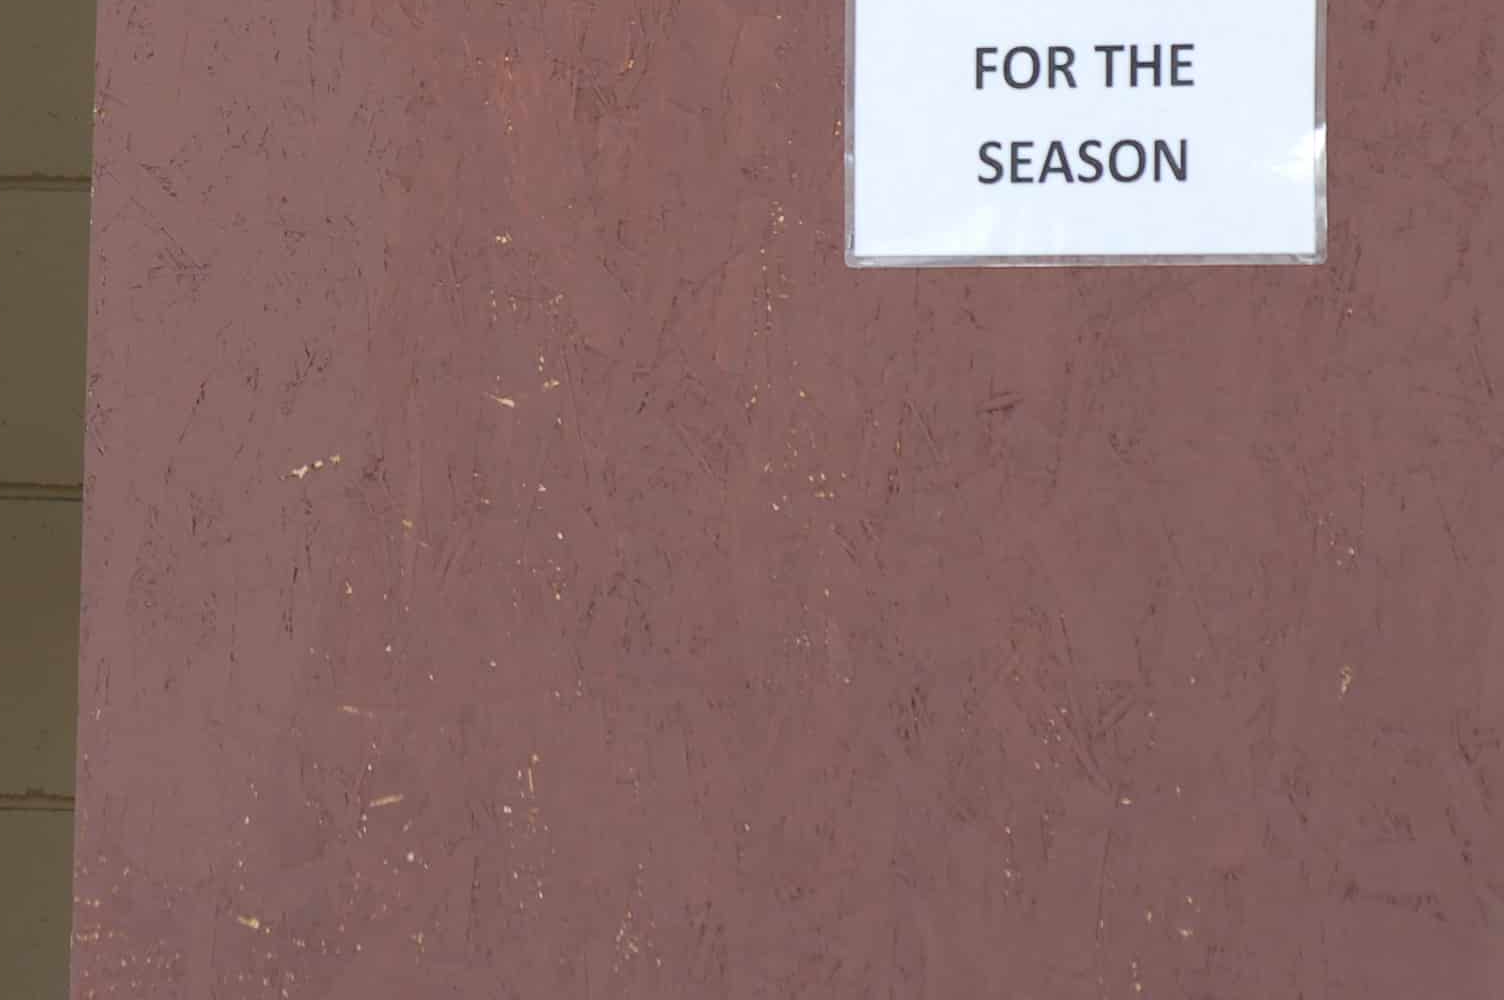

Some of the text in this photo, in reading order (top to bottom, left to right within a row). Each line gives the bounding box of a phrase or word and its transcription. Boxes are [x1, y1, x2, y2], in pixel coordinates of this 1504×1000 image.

[975, 43, 1195, 90] FOR THE
[977, 138, 1188, 185] SEASON
